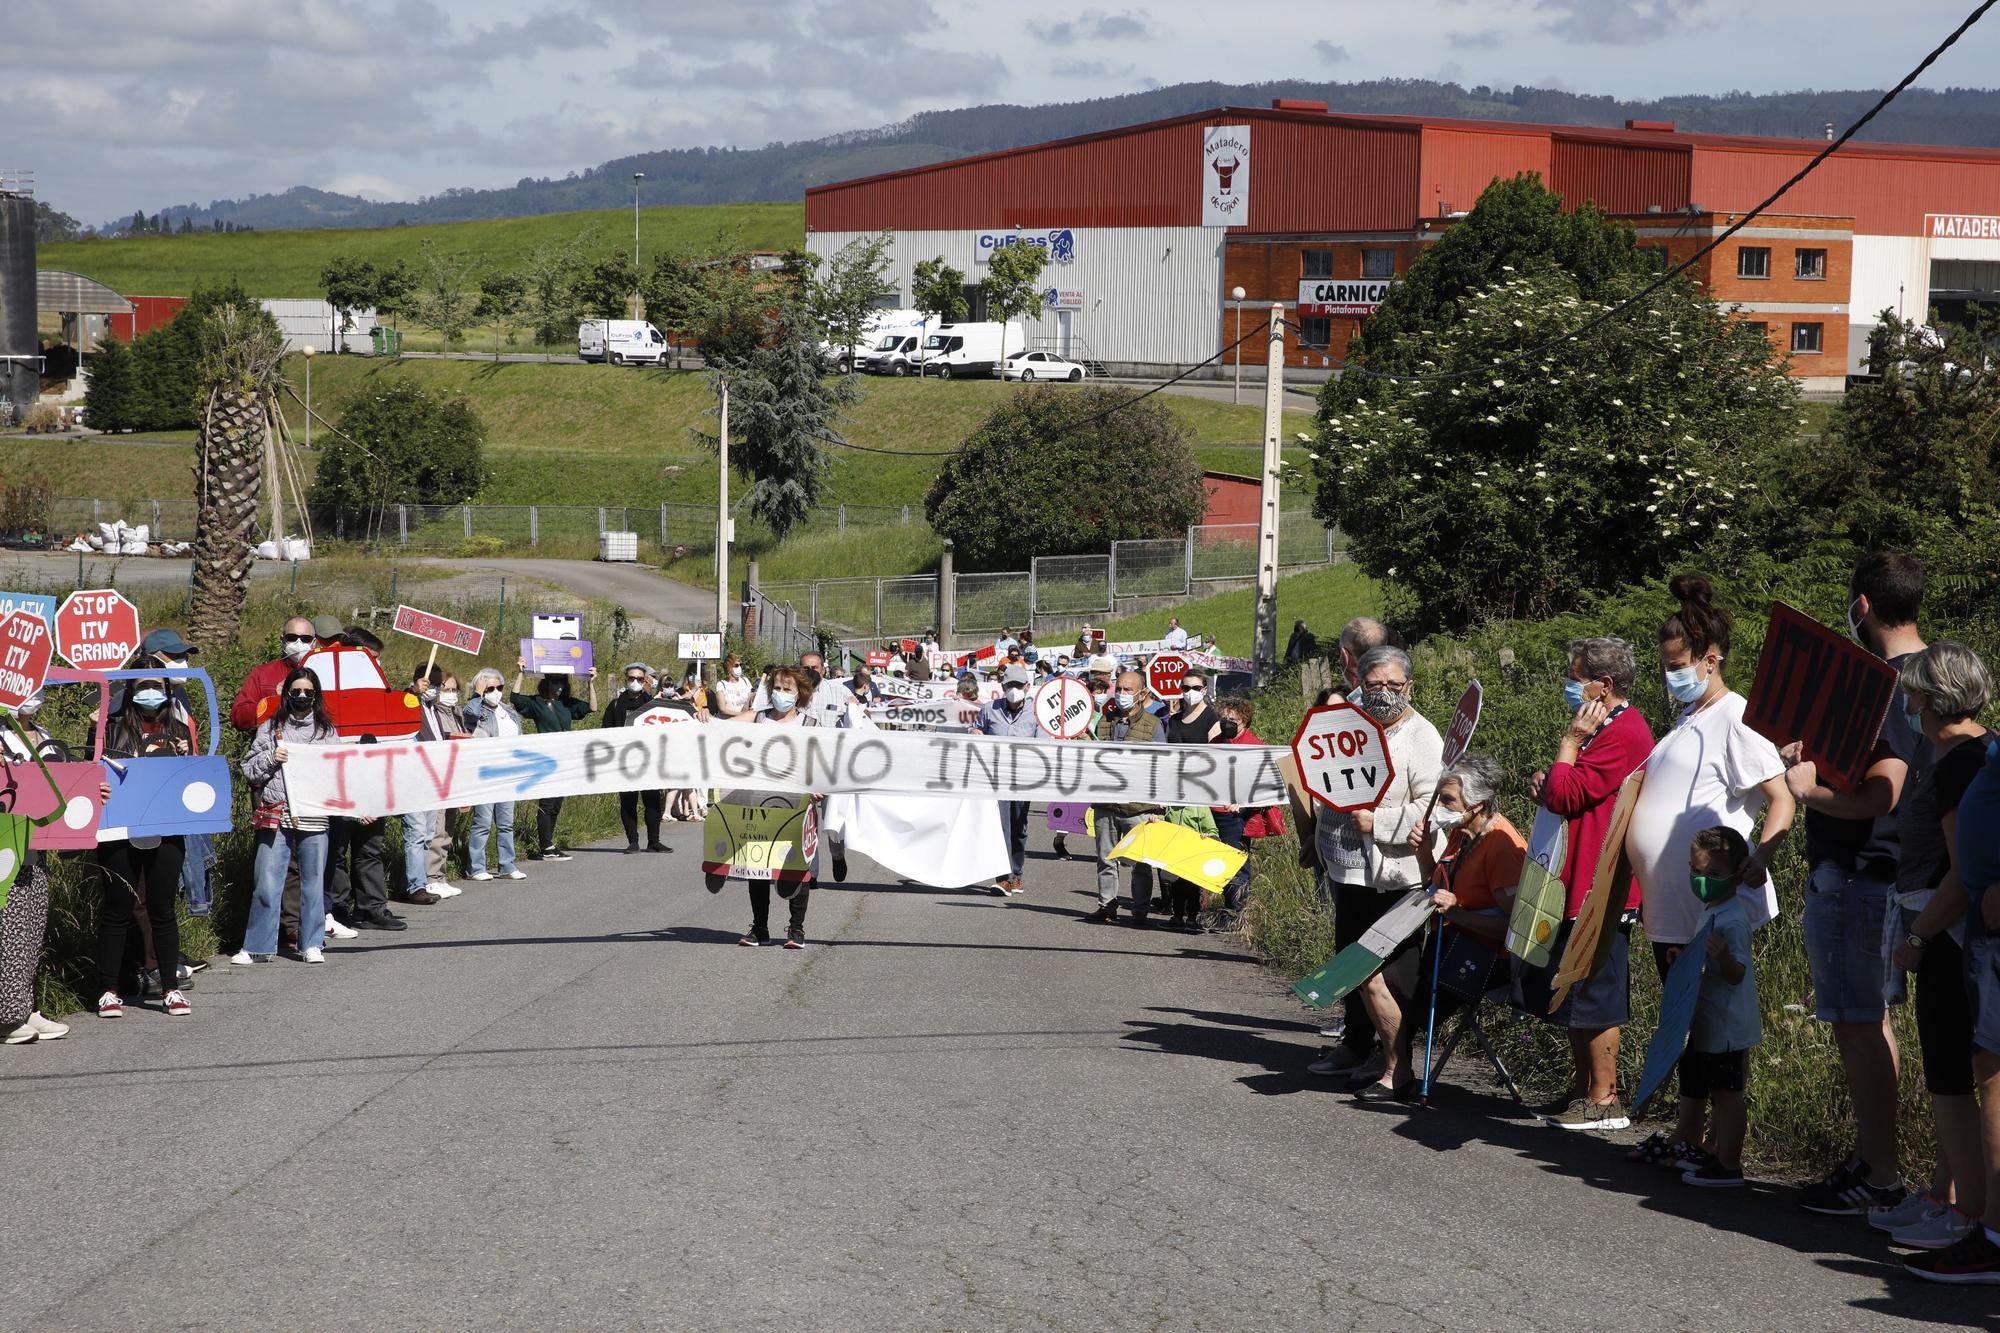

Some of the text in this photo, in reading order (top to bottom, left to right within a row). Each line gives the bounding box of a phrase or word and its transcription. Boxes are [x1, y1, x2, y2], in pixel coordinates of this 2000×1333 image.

[1206, 137, 1248, 157] Matadero
[1211, 196, 1240, 215] de Gijón
[1933, 217, 2000, 238] MATADER
[1325, 305, 1368, 314] Plataforma
[73, 596, 119, 616] STOP
[8, 617, 44, 645] STOP
[81, 621, 109, 640] ITV
[692, 634, 709, 642] ITV
[4, 645, 31, 670] ITV
[71, 642, 129, 663] GRANDA
[1154, 661, 1184, 673] STOP
[0, 669, 35, 698] RANDA
[1160, 679, 1182, 690] ITV
[1452, 709, 1473, 739] STOP
[1308, 729, 1368, 760] STOP
[1444, 737, 1460, 760] ITV
[322, 742, 460, 810] ITV
[583, 732, 893, 786] POLIGONO
[1322, 766, 1377, 793] ITV
[742, 807, 769, 821] ITV
[740, 832, 769, 841] GRANDA
[737, 843, 764, 862] NO
[736, 867, 770, 877] GRANDA
